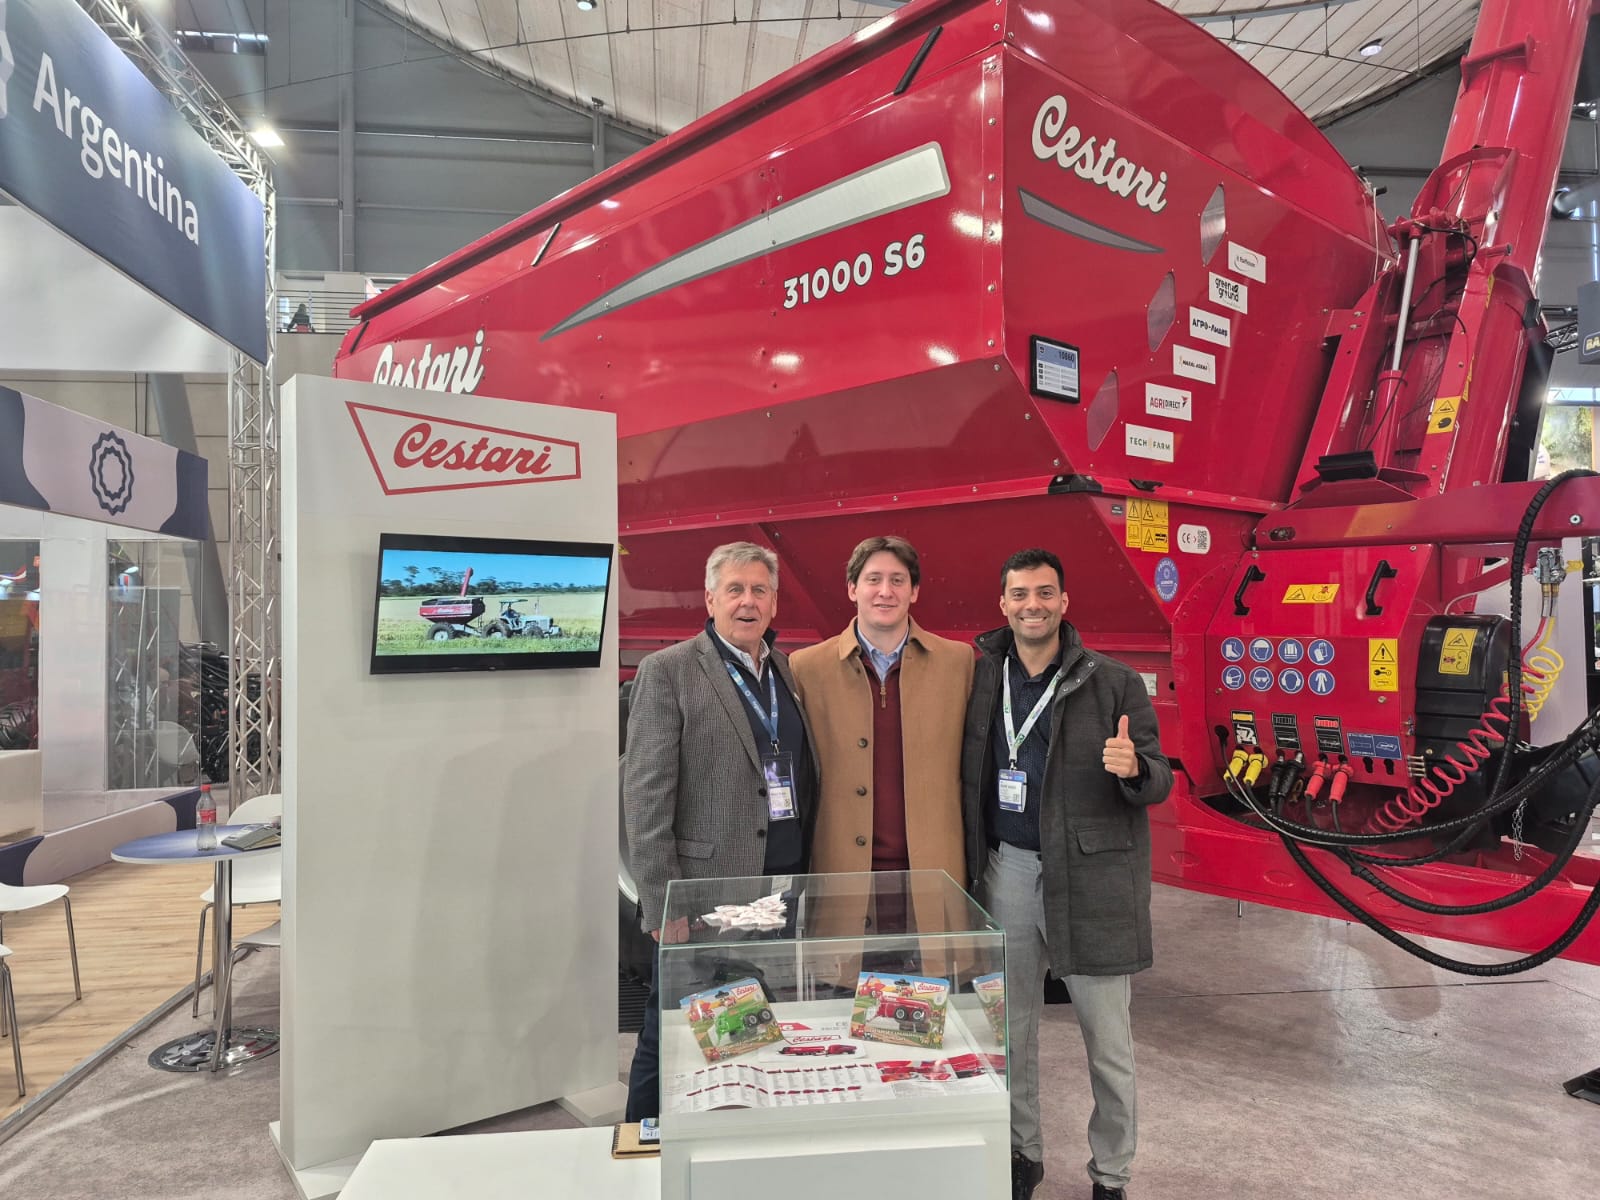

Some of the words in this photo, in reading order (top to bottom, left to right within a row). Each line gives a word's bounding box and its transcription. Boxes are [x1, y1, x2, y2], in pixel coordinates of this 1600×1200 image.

[33, 53, 199, 245] Argentina
[1031, 94, 1167, 213] Cestari
[783, 252, 873, 309] 31000
[883, 233, 926, 277] S6
[393, 422, 551, 475] Cestari
[1152, 441, 1171, 450] FARM
